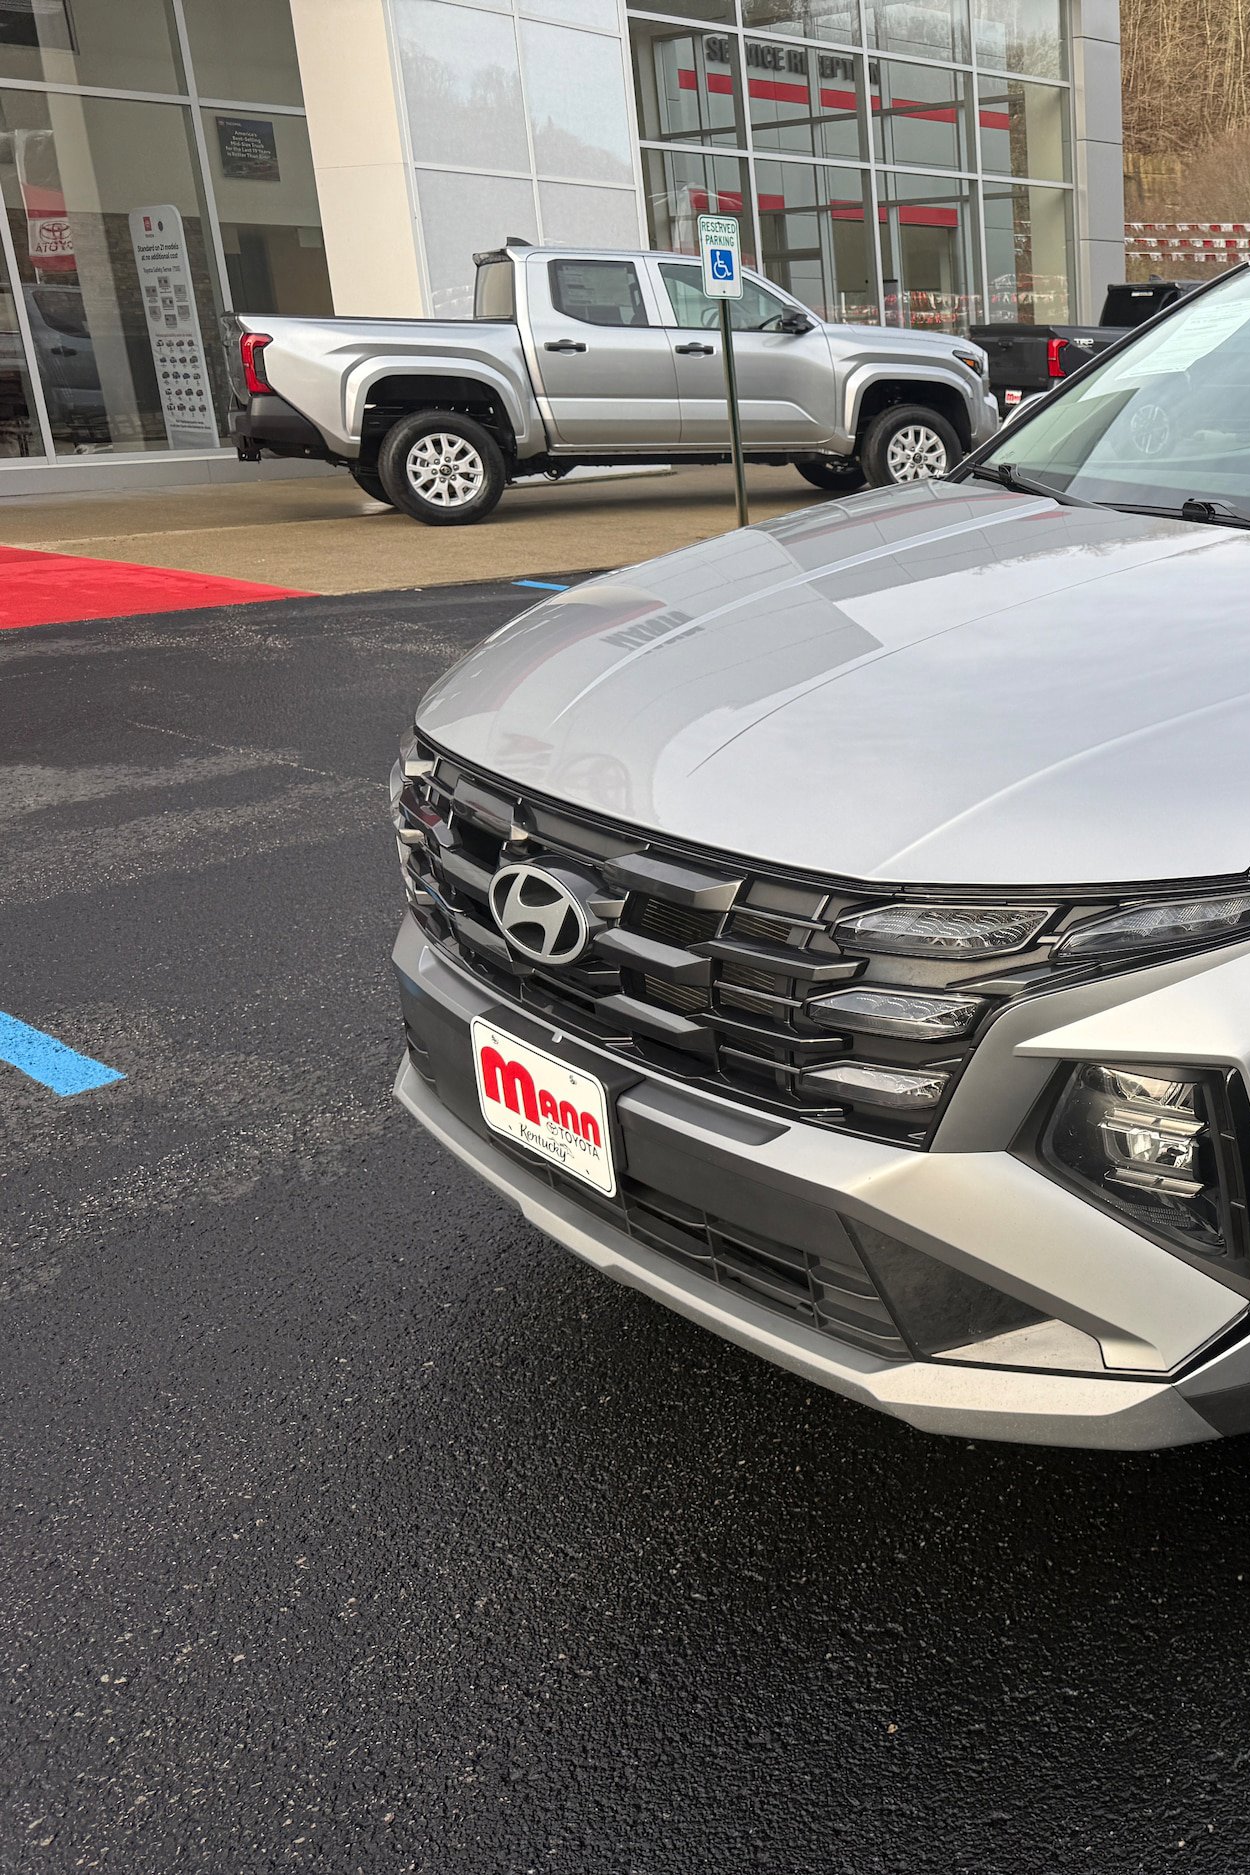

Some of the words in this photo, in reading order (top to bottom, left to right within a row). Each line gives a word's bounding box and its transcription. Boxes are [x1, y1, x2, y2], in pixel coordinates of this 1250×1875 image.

[706, 36, 785, 71] SEVICE
[701, 221, 736, 234] RESERVED
[705, 235, 735, 247] PARKING
[520, 1122, 568, 1162] Kentucky
[558, 1127, 600, 1160] TOYOTA
